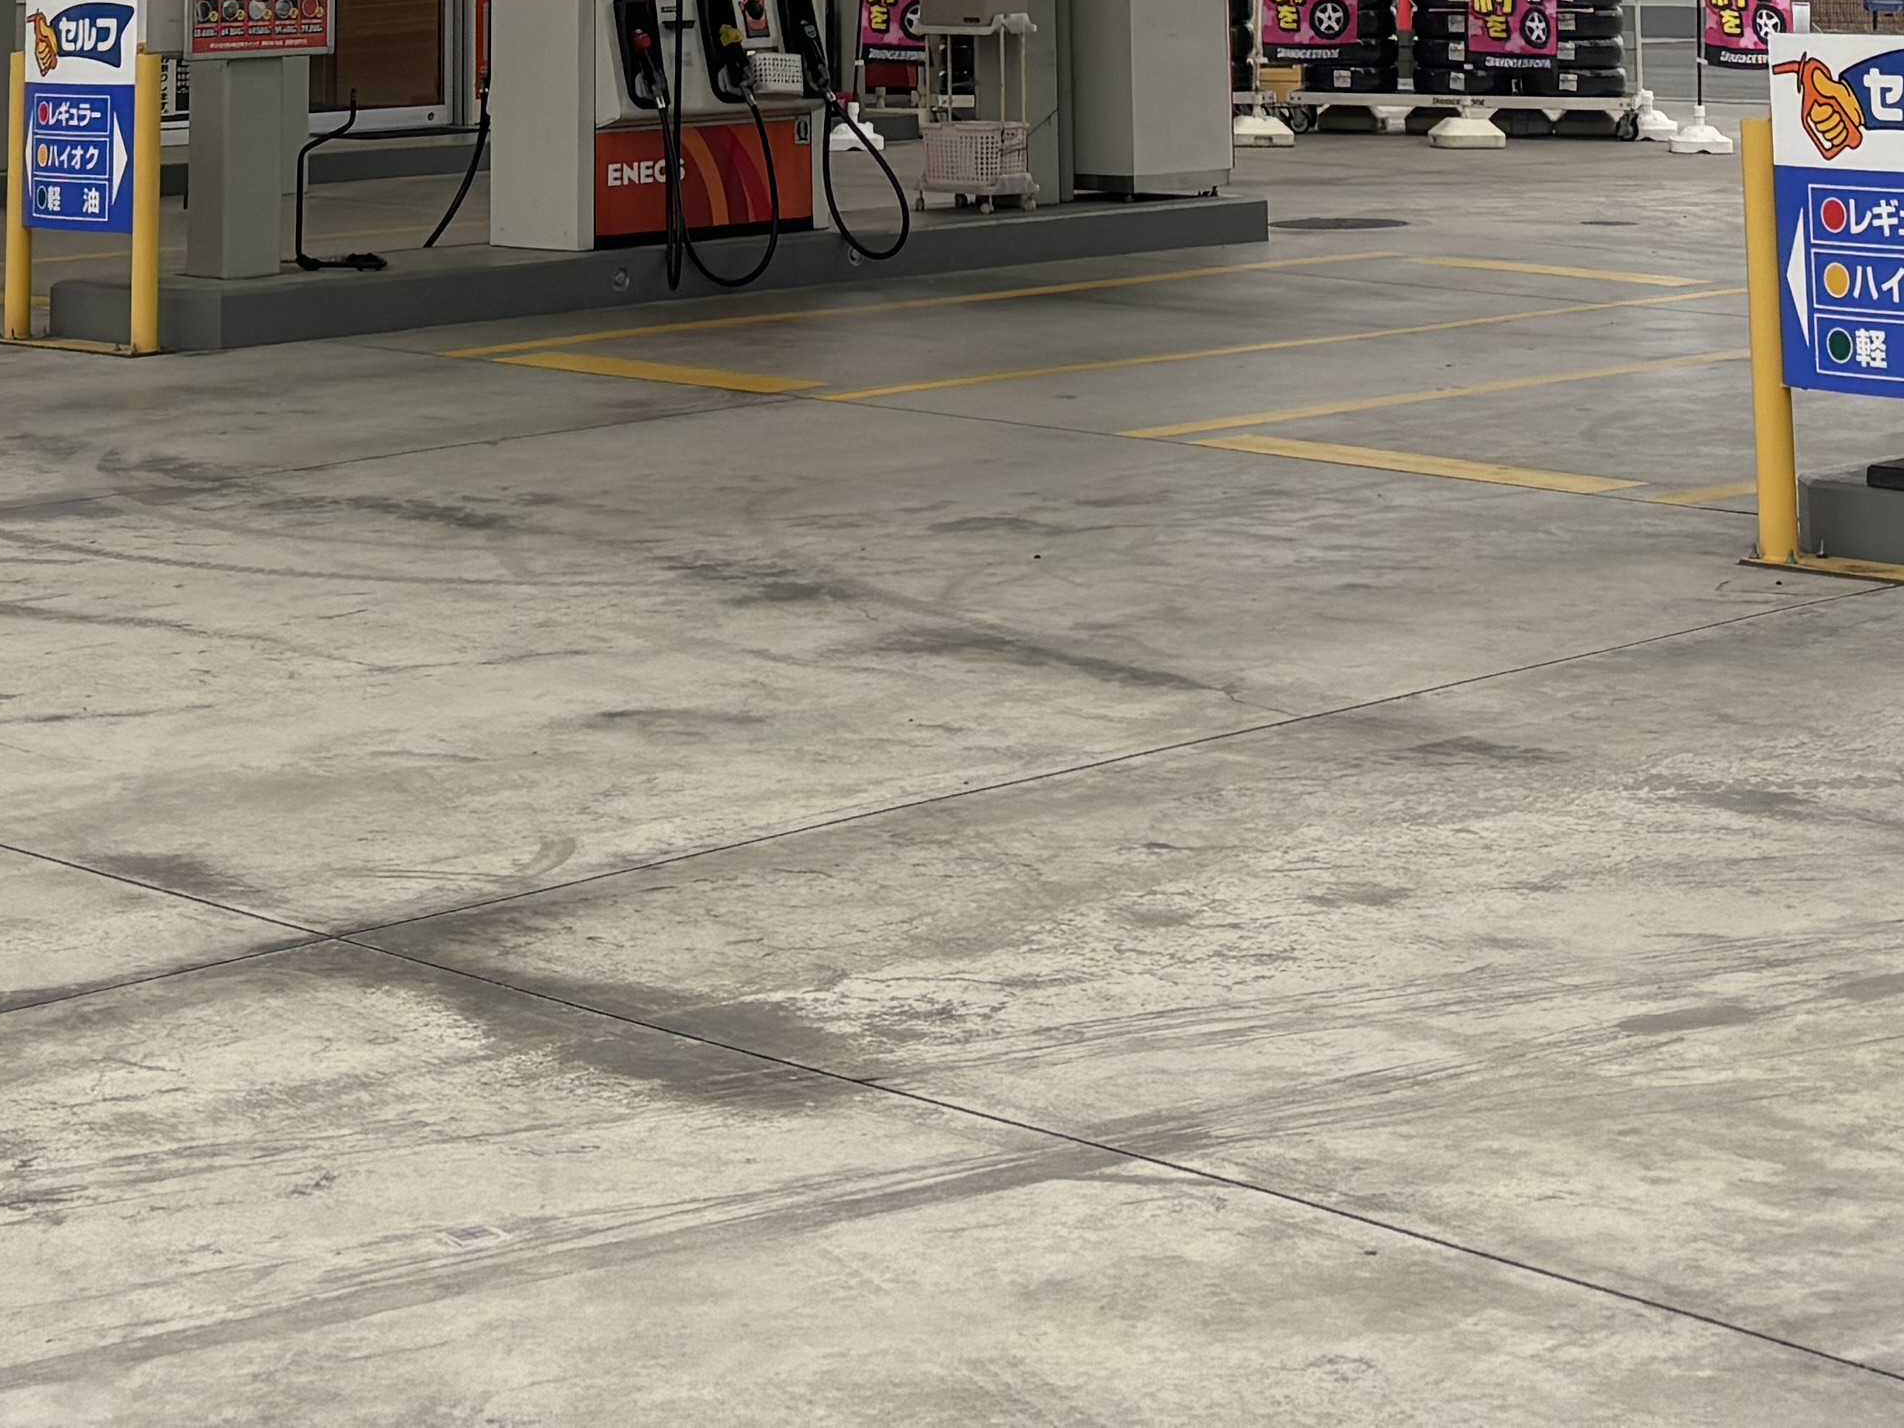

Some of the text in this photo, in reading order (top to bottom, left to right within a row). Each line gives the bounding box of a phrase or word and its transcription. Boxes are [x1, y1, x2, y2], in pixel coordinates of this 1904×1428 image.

[58, 16, 118, 52] セルフ
[49, 101, 102, 127] レギュラー
[49, 144, 100, 170] ハイオク
